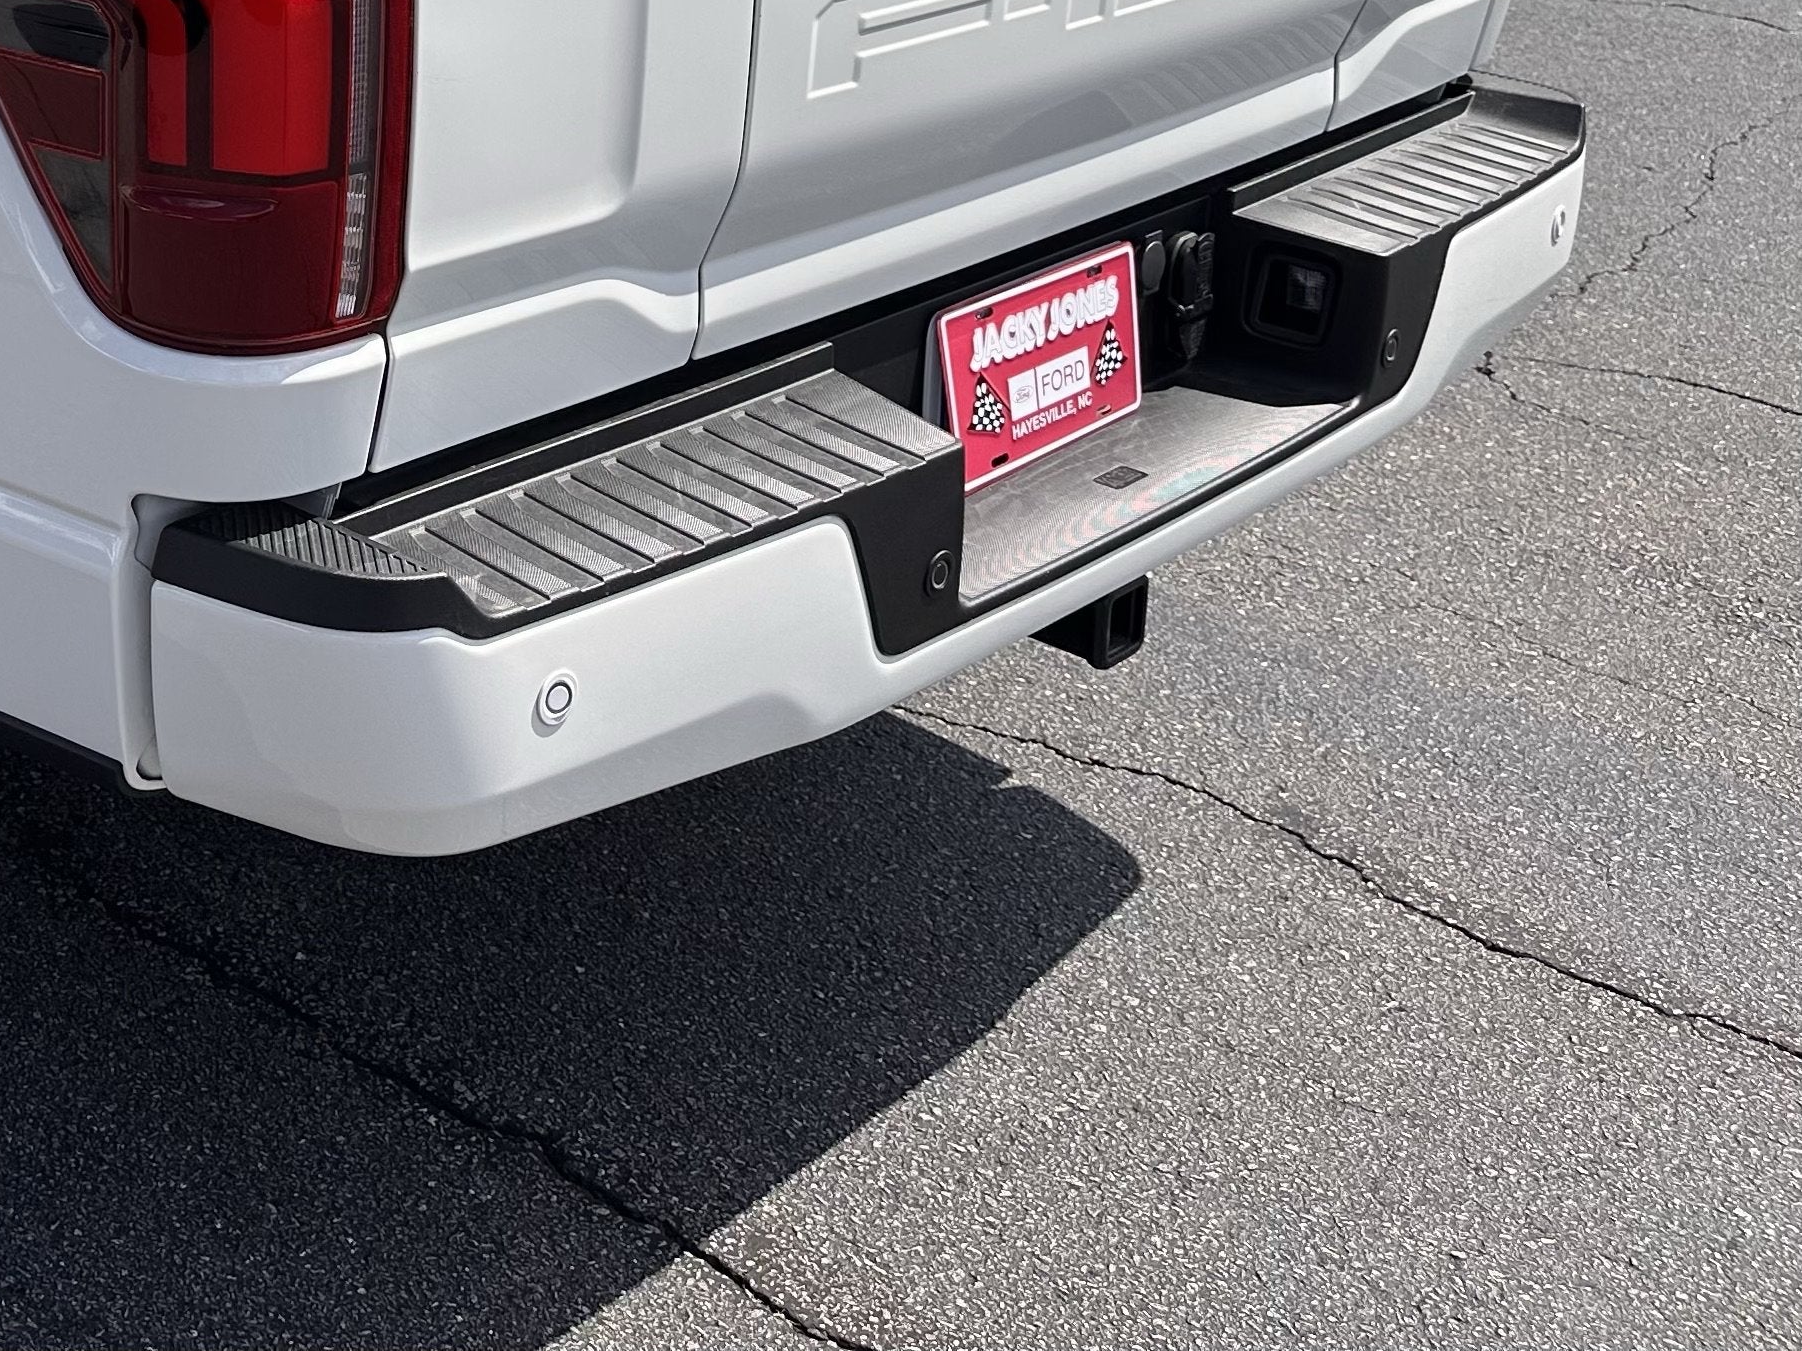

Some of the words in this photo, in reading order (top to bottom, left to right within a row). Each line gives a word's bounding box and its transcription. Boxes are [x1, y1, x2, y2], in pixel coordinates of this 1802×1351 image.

[970, 301, 1049, 373] JACKY
[1048, 274, 1119, 342] JONES
[1041, 359, 1085, 397] FORD
[1011, 401, 1077, 441] HAYESVILLE,
[1077, 391, 1093, 409] NC
